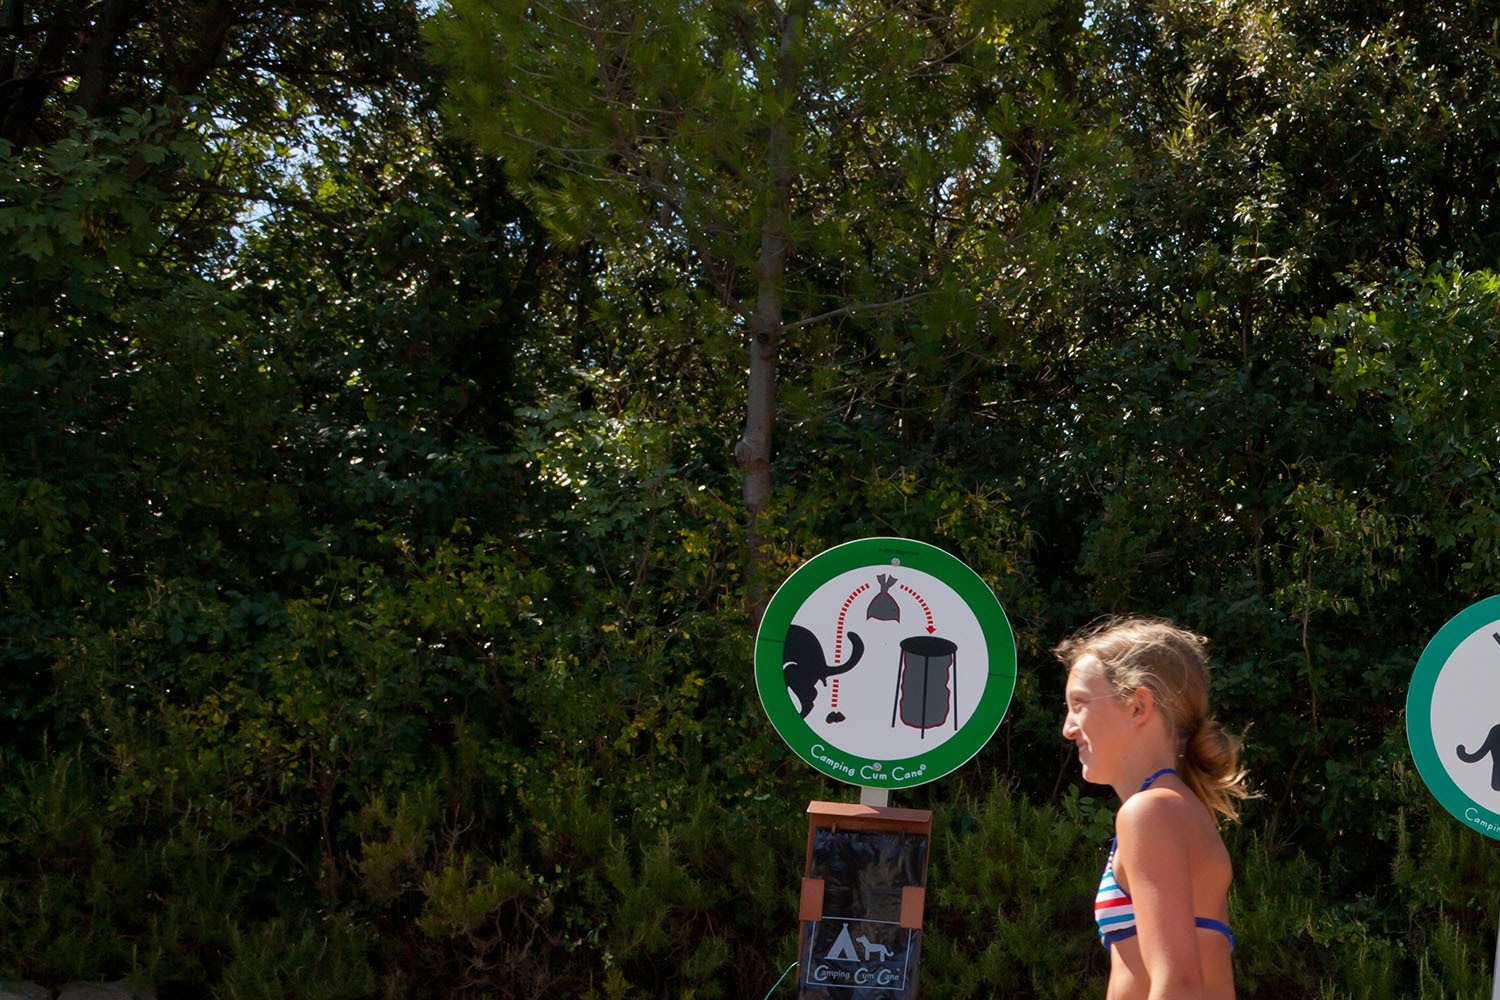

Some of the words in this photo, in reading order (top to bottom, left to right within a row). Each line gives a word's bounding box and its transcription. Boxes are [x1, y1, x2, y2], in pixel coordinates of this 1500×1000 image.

[810, 743, 855, 777] Camping
[860, 765, 887, 780] Cum
[813, 964, 851, 982] Camping
[853, 967, 875, 984] Cum
